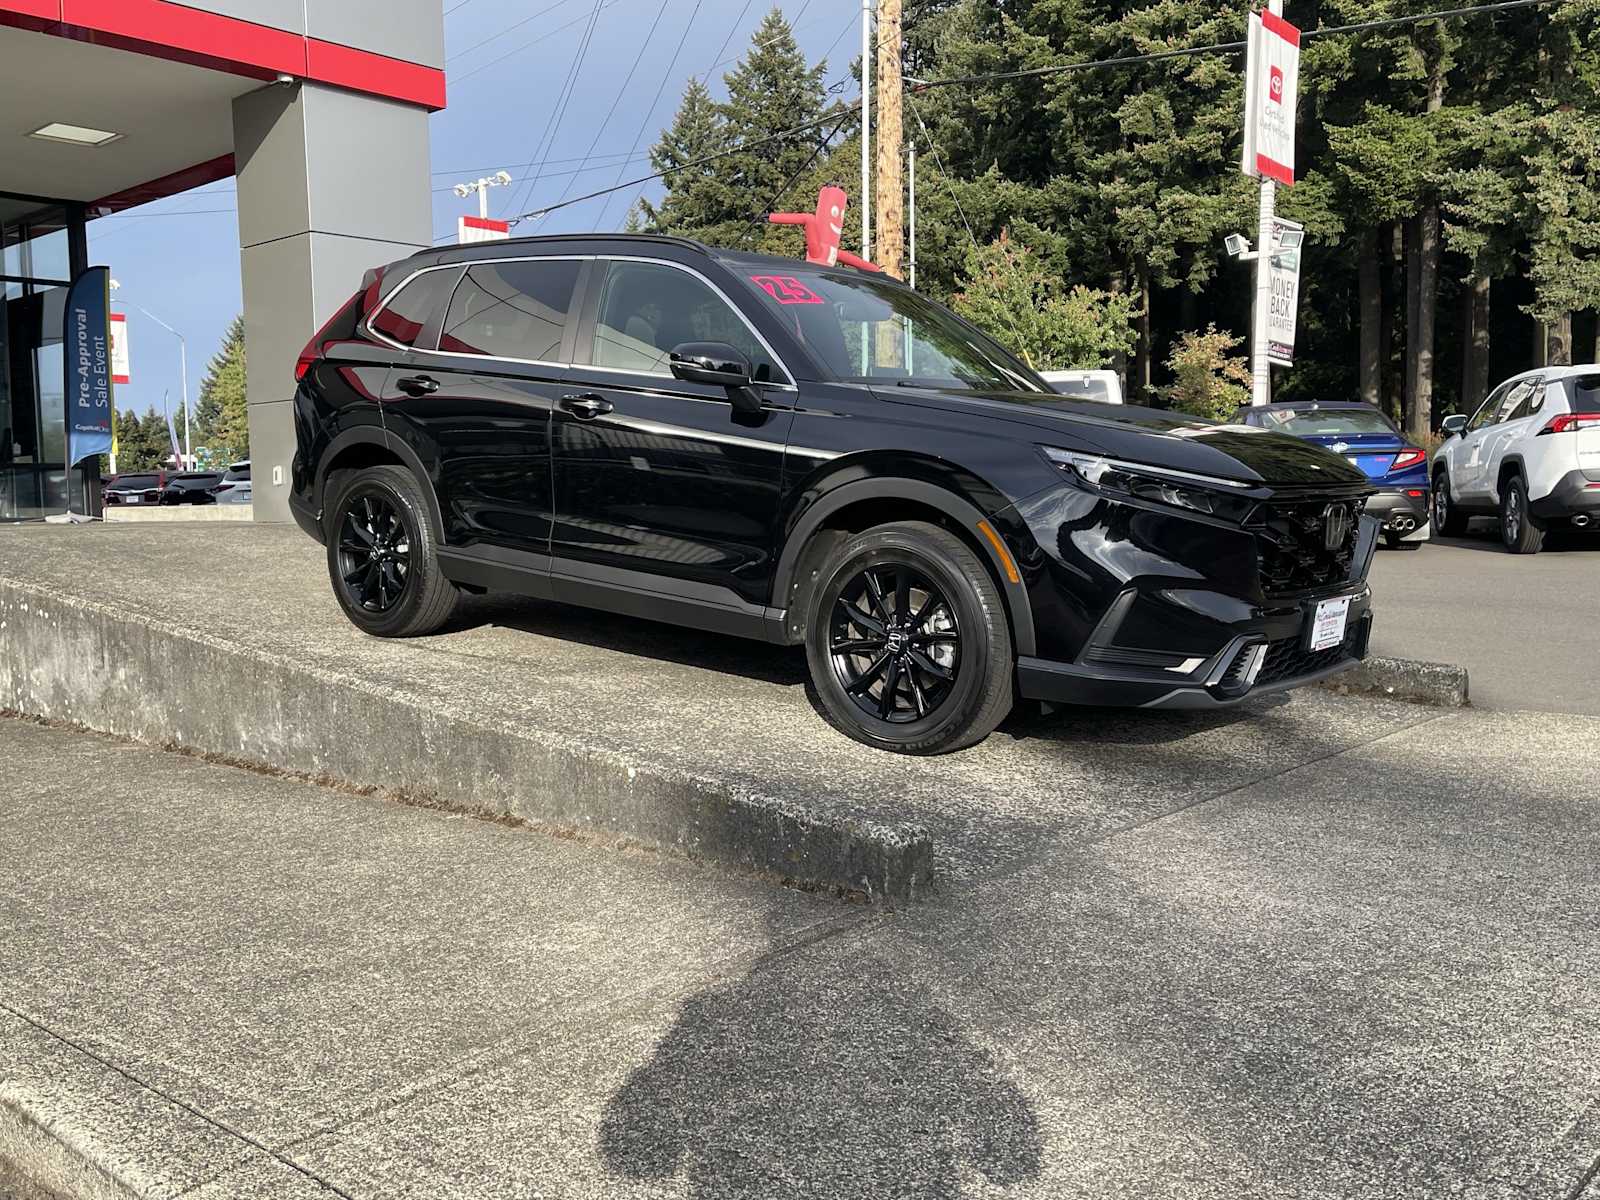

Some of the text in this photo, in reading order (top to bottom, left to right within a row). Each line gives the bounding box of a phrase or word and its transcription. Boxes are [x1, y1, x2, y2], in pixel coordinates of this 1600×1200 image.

[757, 278, 814, 301] 25
[1271, 296, 1290, 318] BACK
[75, 308, 91, 408] Pre-Approval
[94, 336, 107, 408] Sale Event
